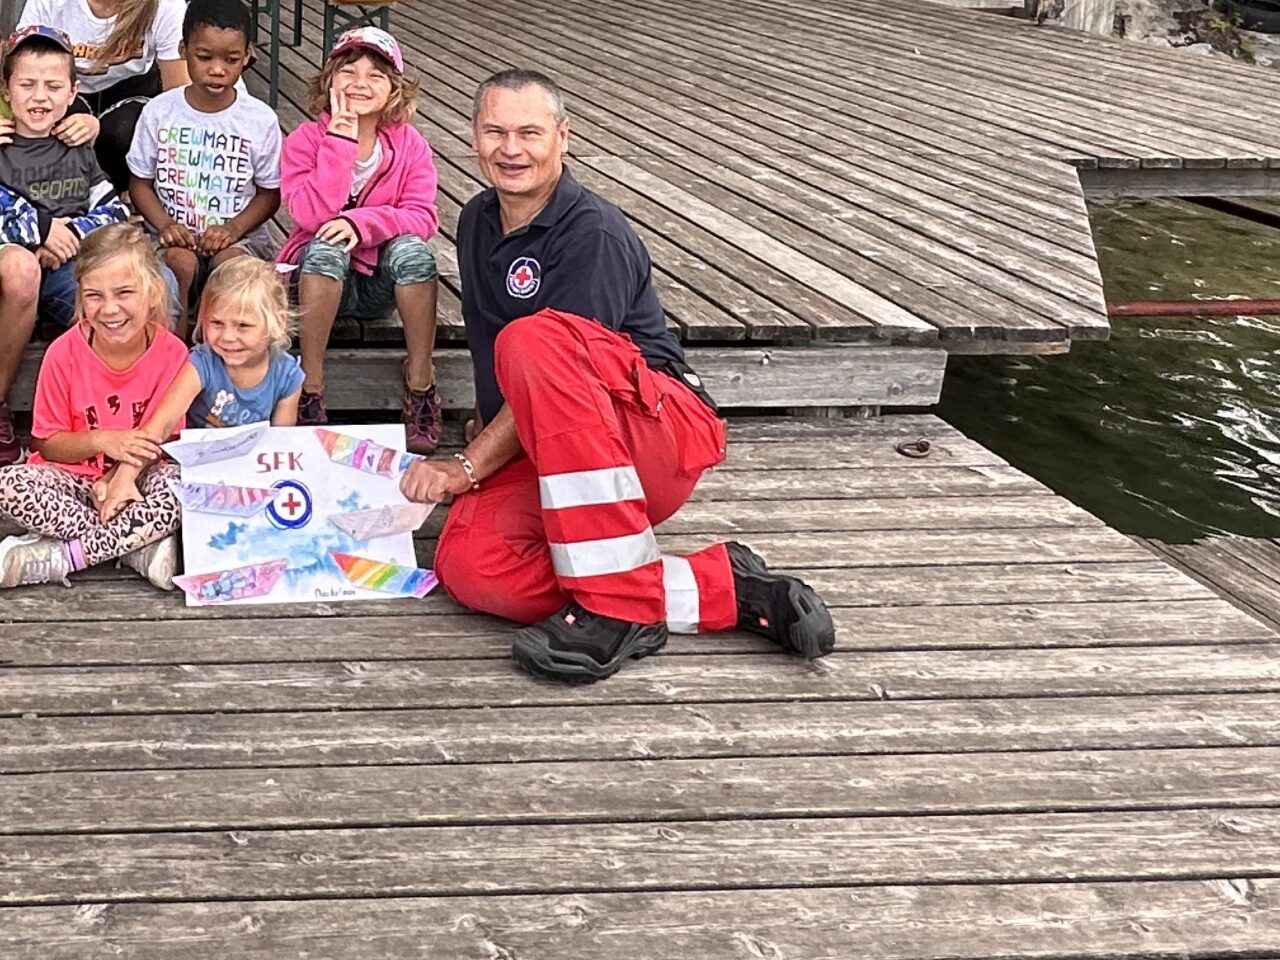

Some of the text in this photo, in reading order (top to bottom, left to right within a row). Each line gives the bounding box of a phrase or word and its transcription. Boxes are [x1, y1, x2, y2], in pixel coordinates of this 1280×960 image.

[157, 127, 252, 156] CREWMATE
[156, 147, 249, 174] CREWMATE
[29, 177, 86, 201] SPORTS
[156, 167, 247, 194] CREWMATE
[157, 186, 242, 212] CREWMATE
[256, 451, 305, 473] SFK
